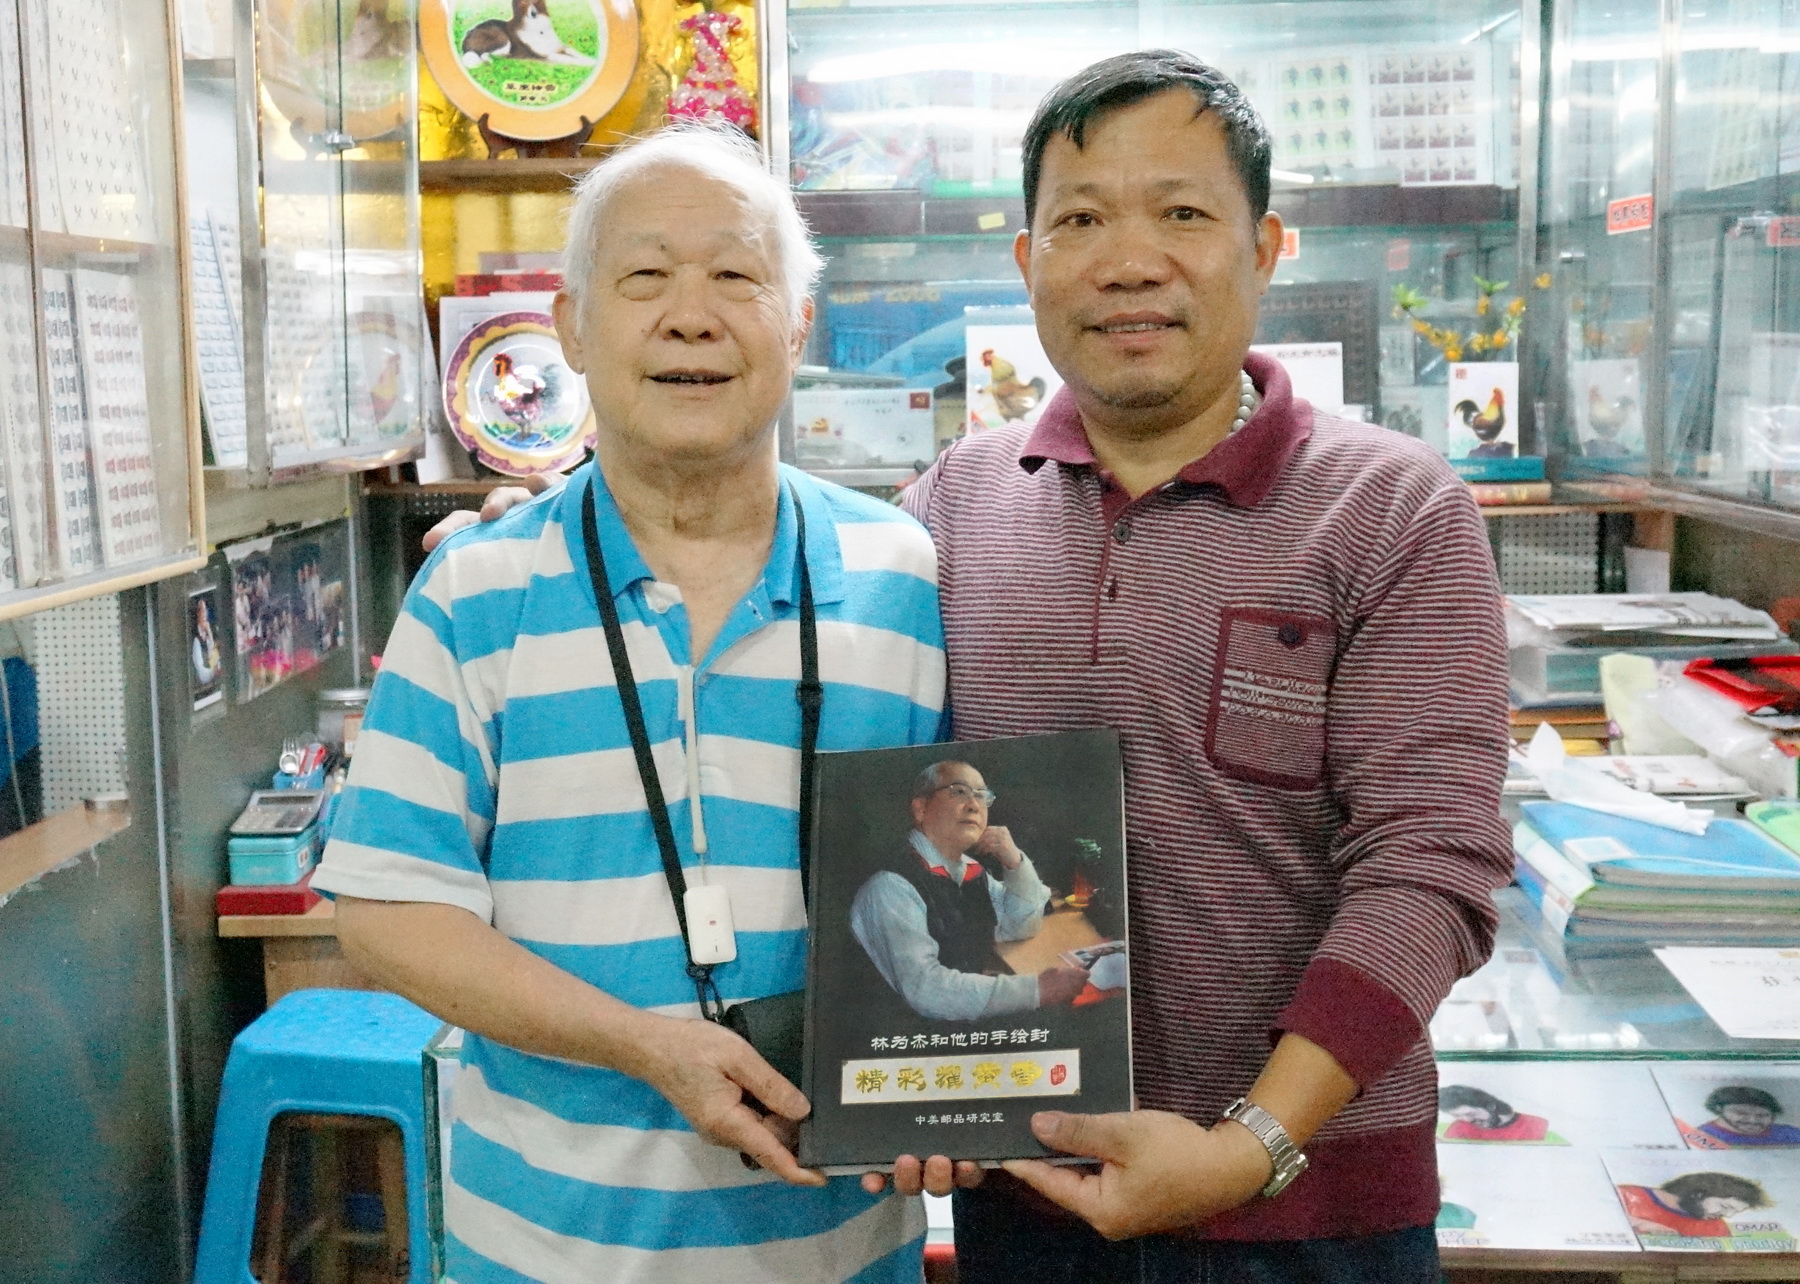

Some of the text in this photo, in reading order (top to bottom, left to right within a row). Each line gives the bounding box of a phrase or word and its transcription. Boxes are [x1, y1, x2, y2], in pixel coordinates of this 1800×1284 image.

[871, 1027, 1050, 1051] 林为杰和他的手绘封
[915, 1111, 1005, 1126] 中美邮品研究室
